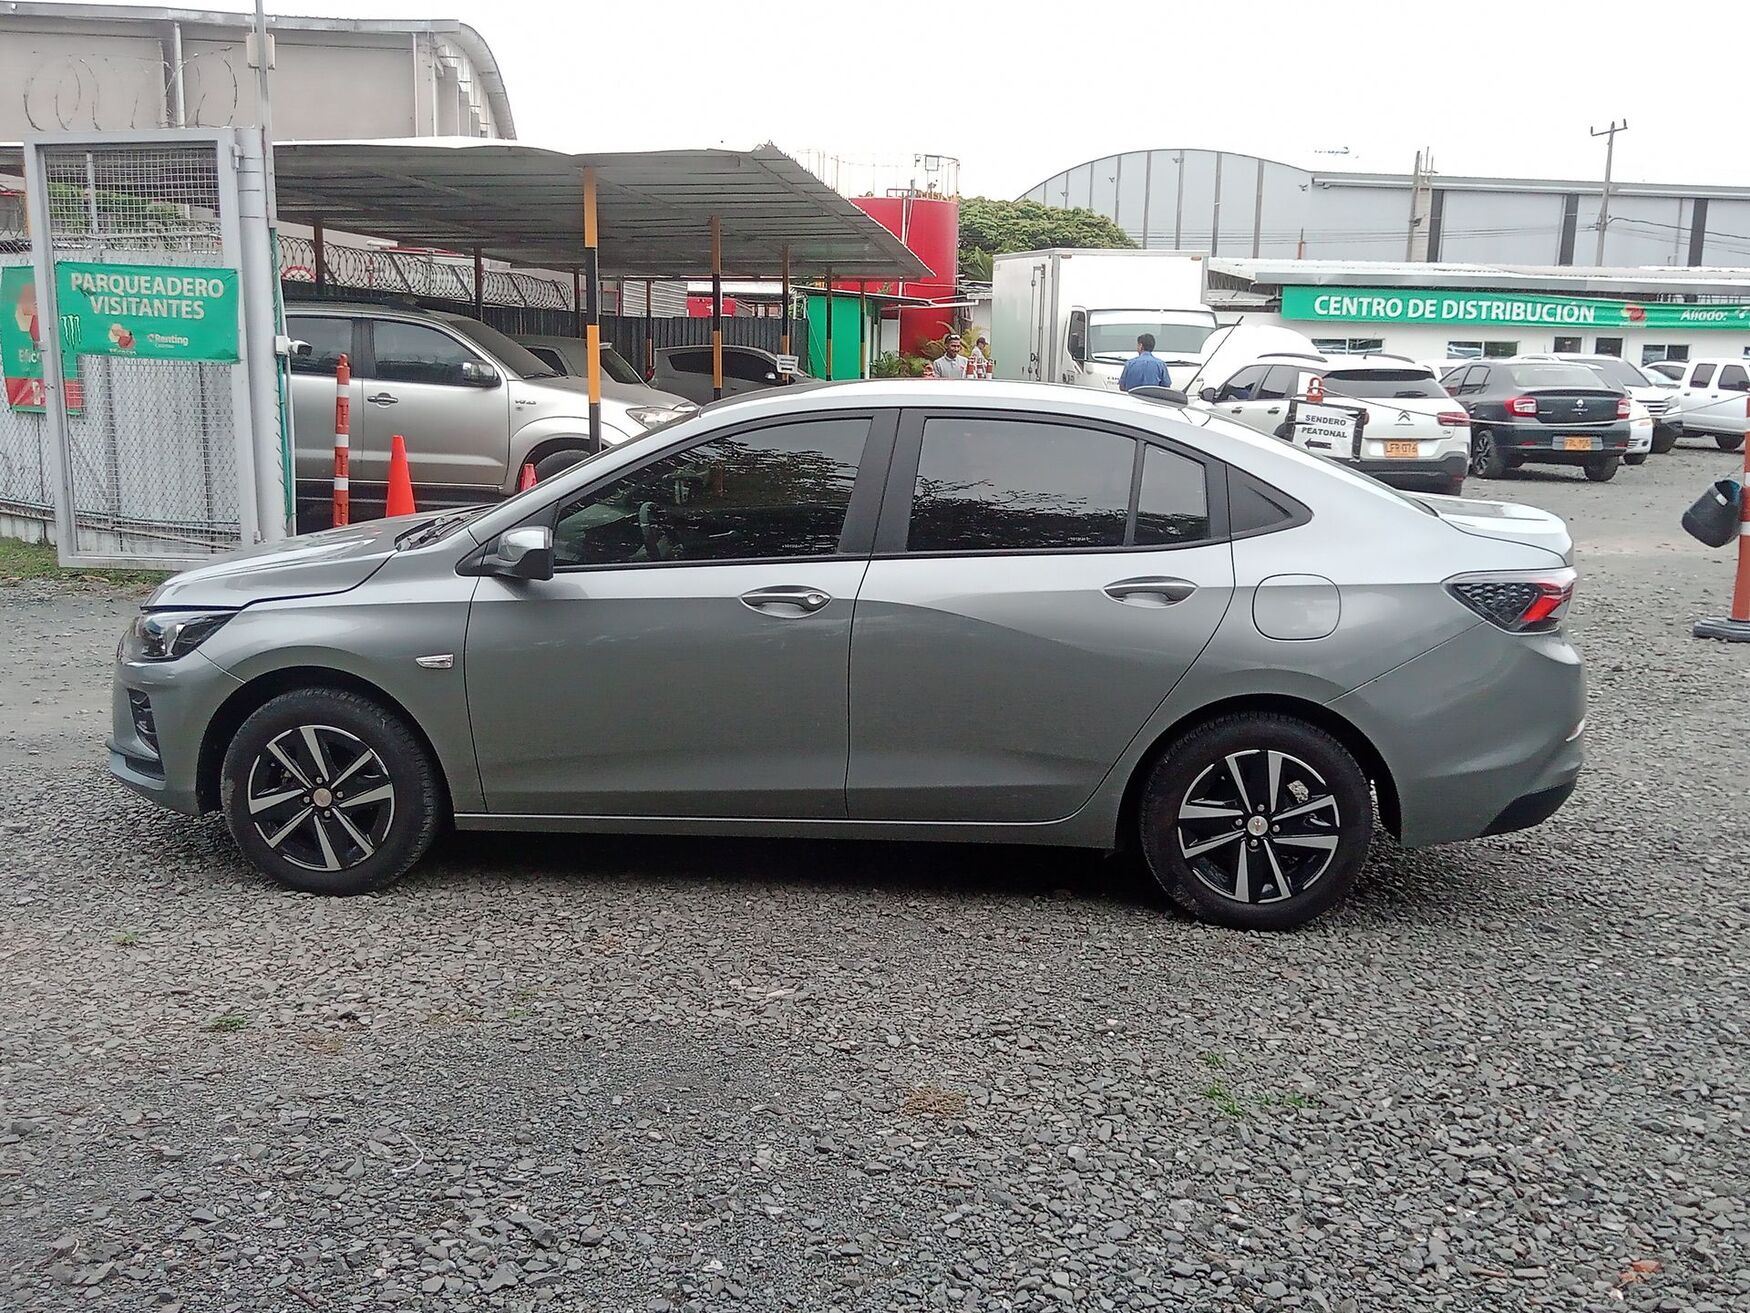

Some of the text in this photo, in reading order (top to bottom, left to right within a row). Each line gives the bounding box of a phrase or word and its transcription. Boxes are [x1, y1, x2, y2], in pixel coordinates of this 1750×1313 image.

[71, 272, 225, 298] PARQUEADERO
[90, 295, 205, 320] VISITANTES
[1314, 296, 1595, 322] CENTRO DE DISTRIBUCIÓN
[155, 334, 189, 346] Renting
[1305, 414, 1346, 426] SENDERO
[1301, 426, 1348, 438] PEATONAL
